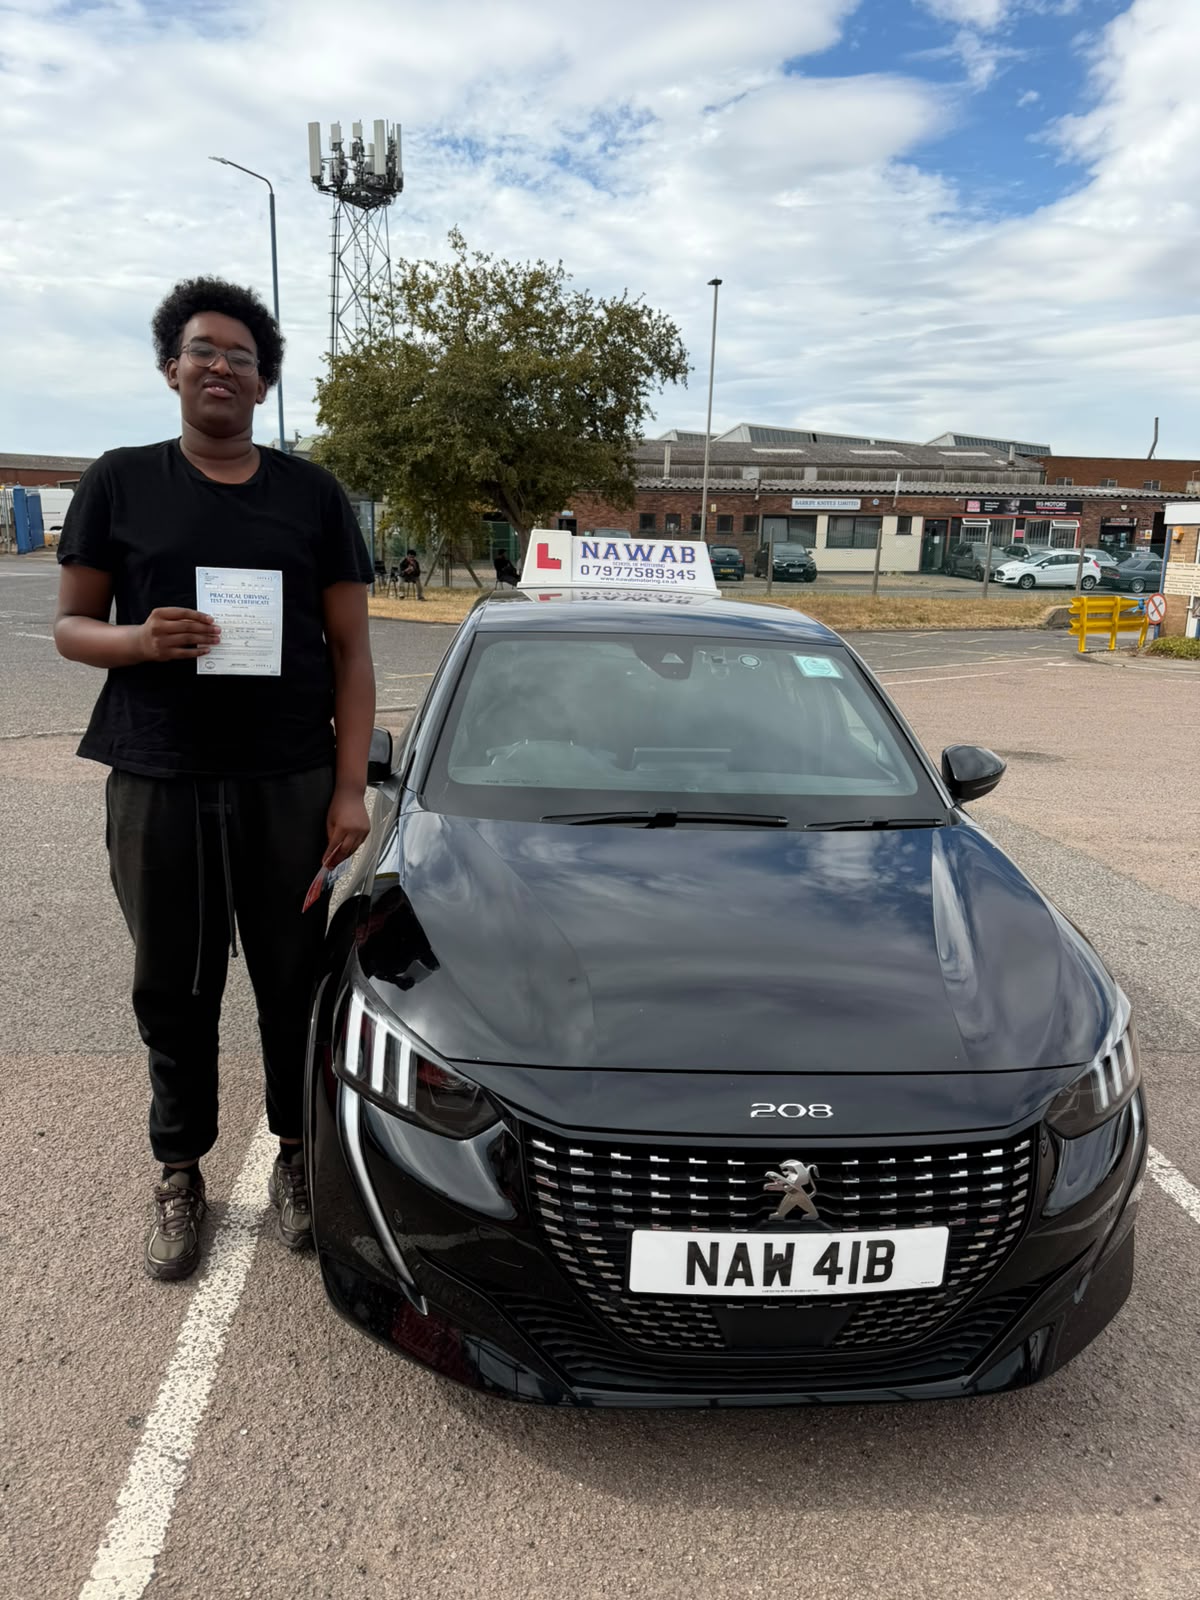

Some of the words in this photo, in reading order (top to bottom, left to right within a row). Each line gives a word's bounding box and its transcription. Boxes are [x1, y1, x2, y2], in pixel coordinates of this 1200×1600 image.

[537, 543, 562, 570] L
[581, 541, 696, 564] NAWAB
[580, 564, 696, 581] 07977589345
[751, 1103, 834, 1118] 208
[686, 1241, 796, 1287] NAW
